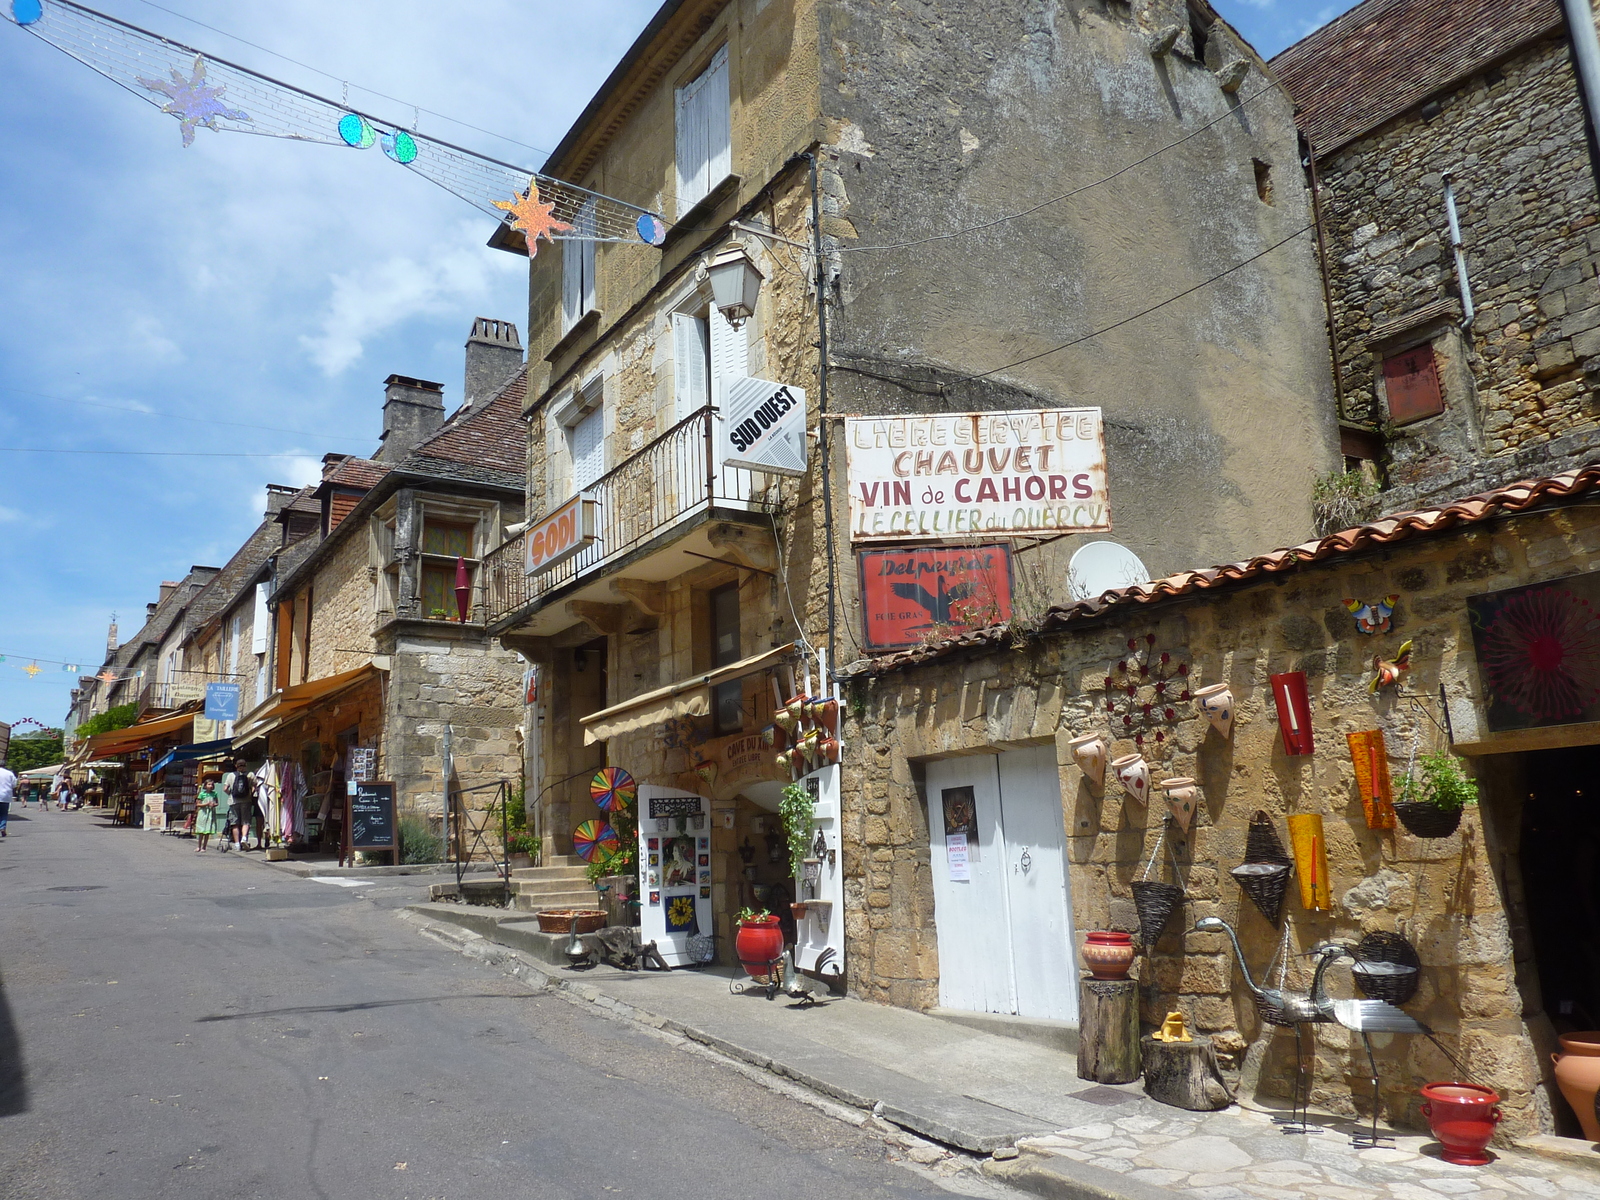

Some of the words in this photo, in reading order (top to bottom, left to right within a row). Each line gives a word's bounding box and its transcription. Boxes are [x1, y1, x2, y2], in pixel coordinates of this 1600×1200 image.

[730, 418, 762, 453] SUD
[754, 386, 798, 430] OUEST
[892, 445, 1054, 477] CHAUVET
[860, 481, 911, 507] VIN
[921, 485, 945, 505] de
[954, 473, 1093, 503] CAHORS
[859, 512, 885, 533] LE
[890, 508, 982, 532] CELLIER
[986, 513, 1007, 530] du
[531, 507, 576, 566] SODI
[877, 554, 994, 580] Delpeyrat
[875, 613, 896, 621] FOIE
[898, 611, 923, 620] GRAS
[727, 739, 745, 760] CAVE
[747, 736, 756, 751] DU
